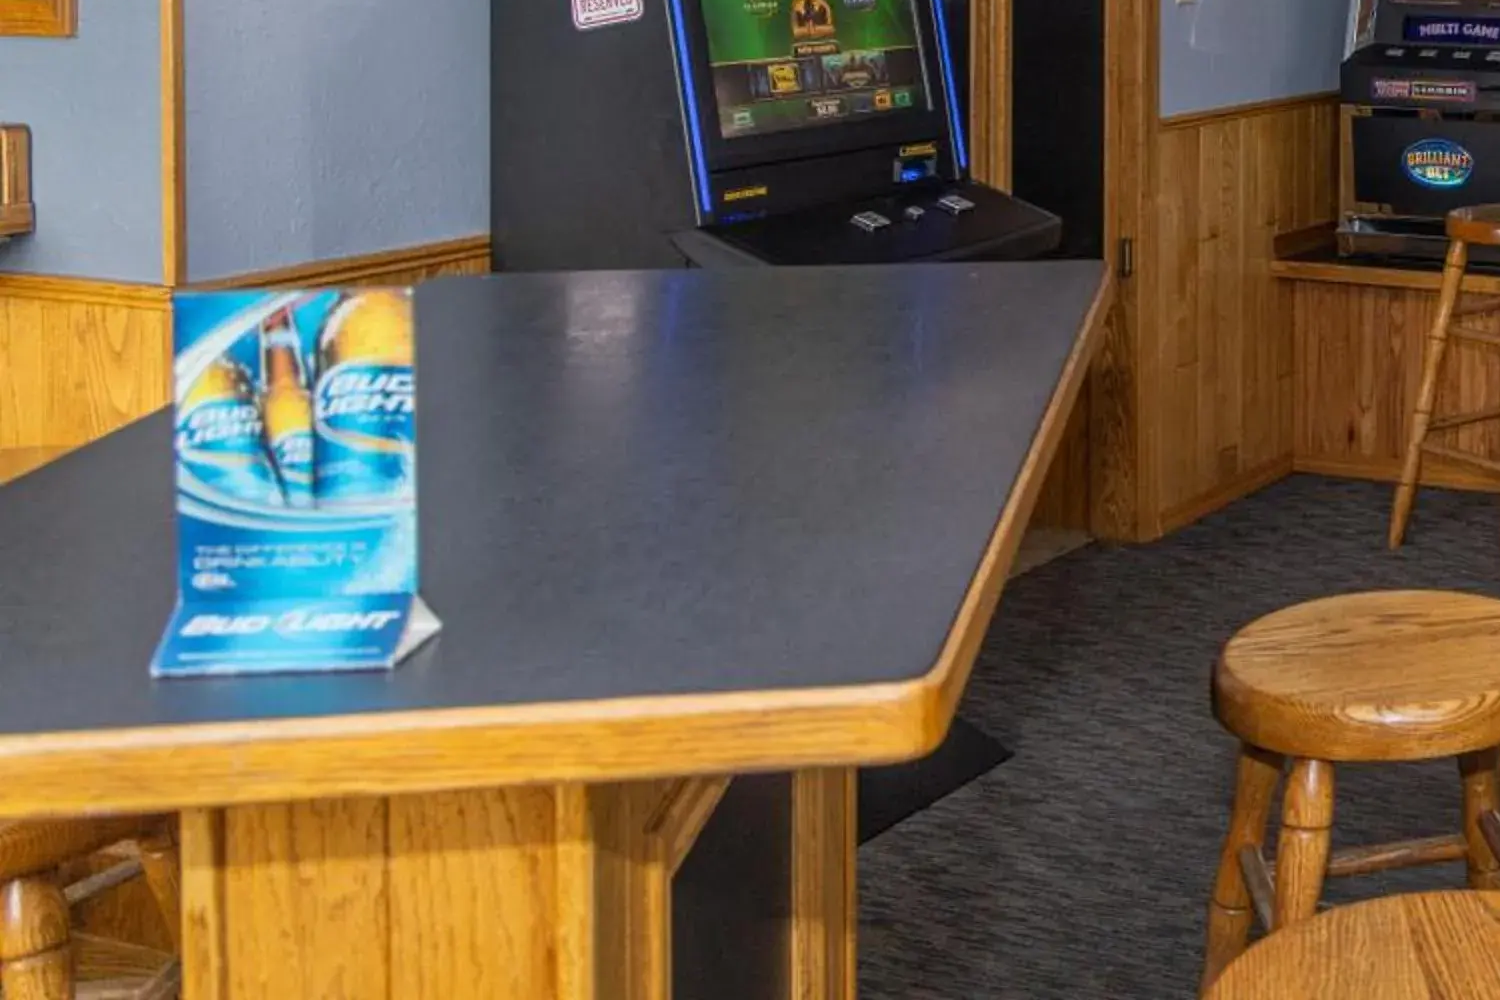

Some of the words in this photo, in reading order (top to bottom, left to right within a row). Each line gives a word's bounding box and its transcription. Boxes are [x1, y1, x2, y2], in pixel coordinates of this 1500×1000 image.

[1418, 20, 1460, 37] MULTI
[1462, 22, 1500, 39] GAME
[1406, 150, 1470, 167] BRILLIANT
[189, 405, 257, 430] BUD
[179, 614, 269, 636] BUD
[275, 608, 401, 633] LIGHT
